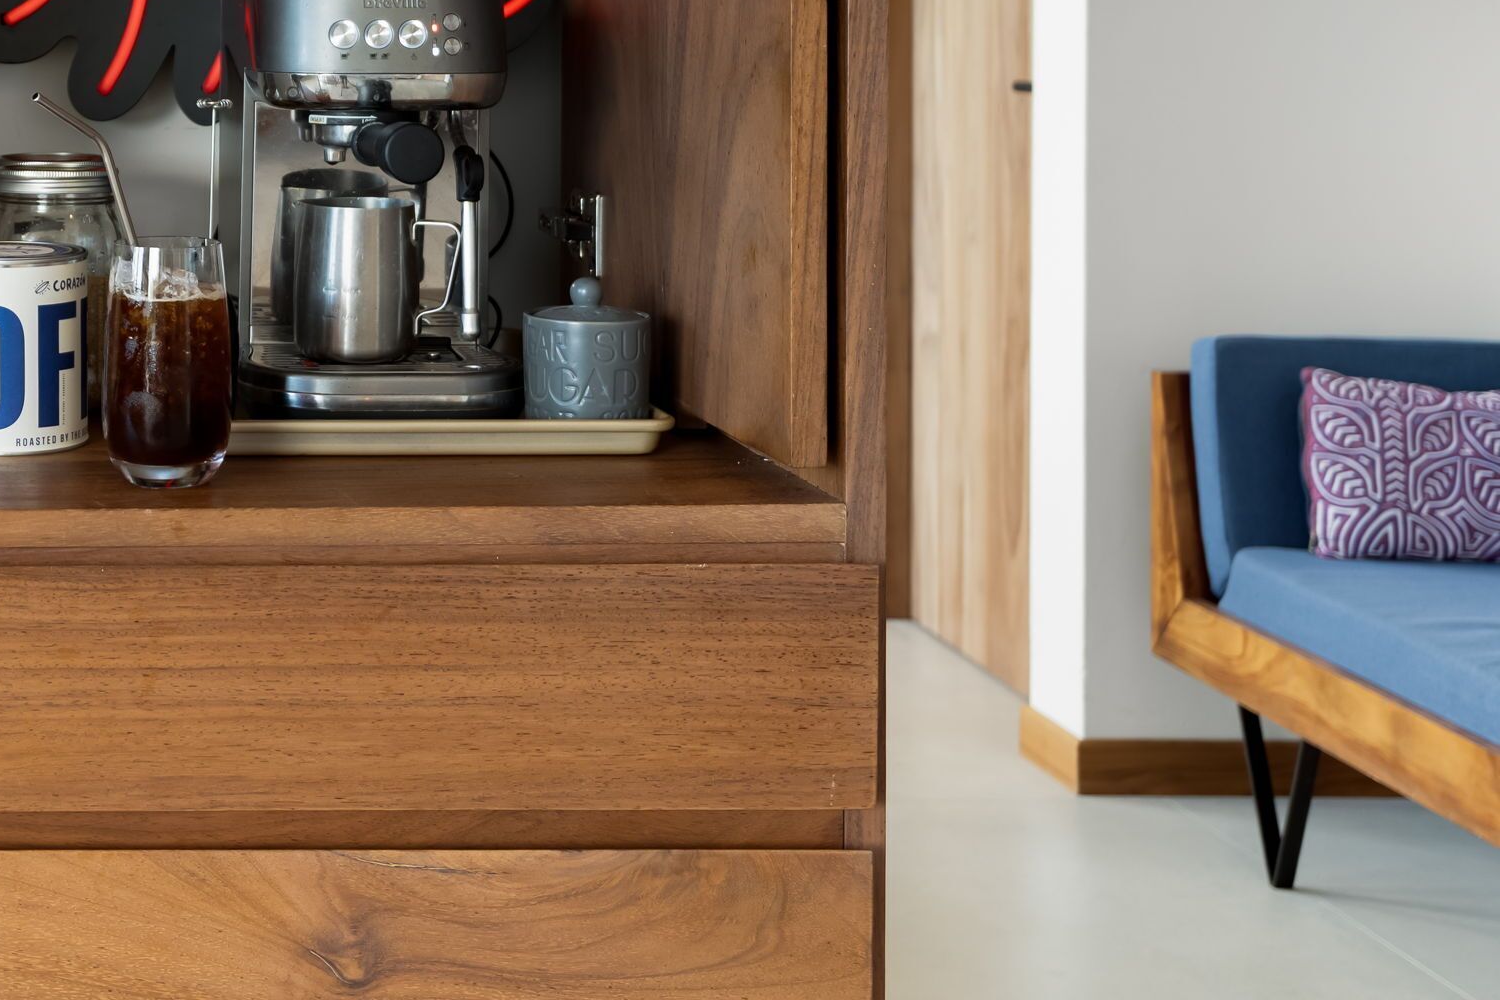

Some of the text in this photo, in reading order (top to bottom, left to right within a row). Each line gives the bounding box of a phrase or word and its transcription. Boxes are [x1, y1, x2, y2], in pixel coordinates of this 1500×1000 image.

[525, 366, 639, 406] UGAR
[15, 434, 57, 447] ROASTED
[60, 432, 69, 443] BY
